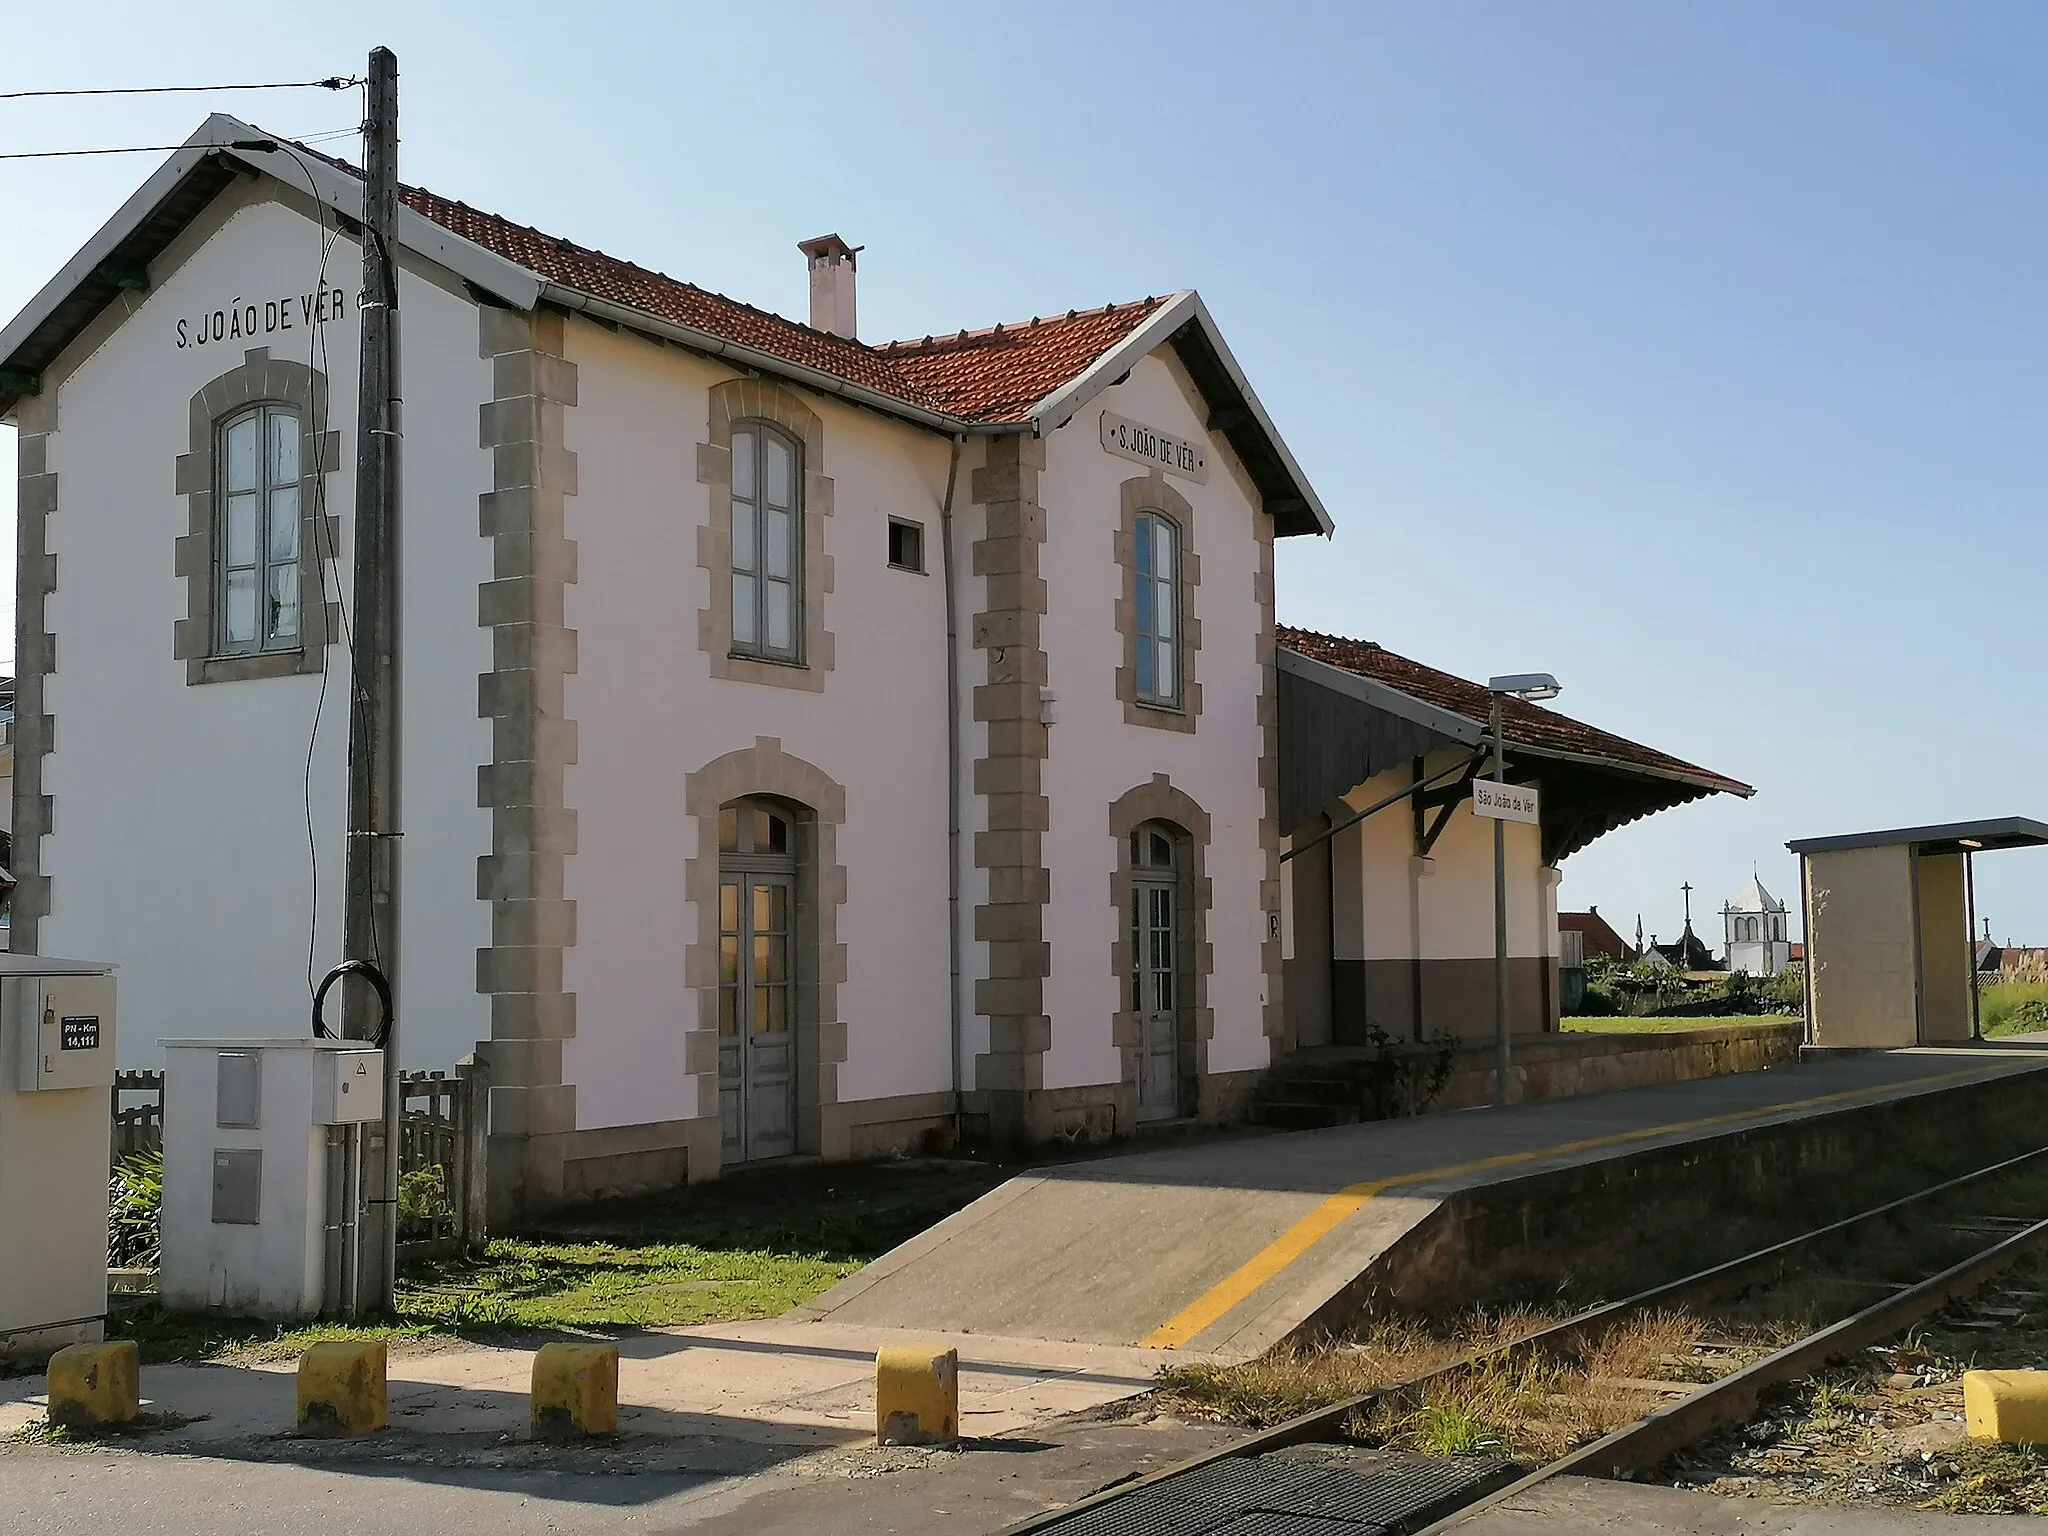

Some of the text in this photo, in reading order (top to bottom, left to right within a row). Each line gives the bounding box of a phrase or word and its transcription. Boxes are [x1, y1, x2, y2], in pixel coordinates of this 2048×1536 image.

[265, 297, 293, 333] DE
[1131, 427, 1156, 459] JOÃO
[1159, 438, 1172, 465] DE
[1176, 441, 1195, 473] VÊR
[1477, 789, 1491, 806] São
[1494, 792, 1510, 809] João
[1512, 796, 1521, 811] de
[65, 1024, 77, 1033] PN
[83, 1023, 97, 1033] Km
